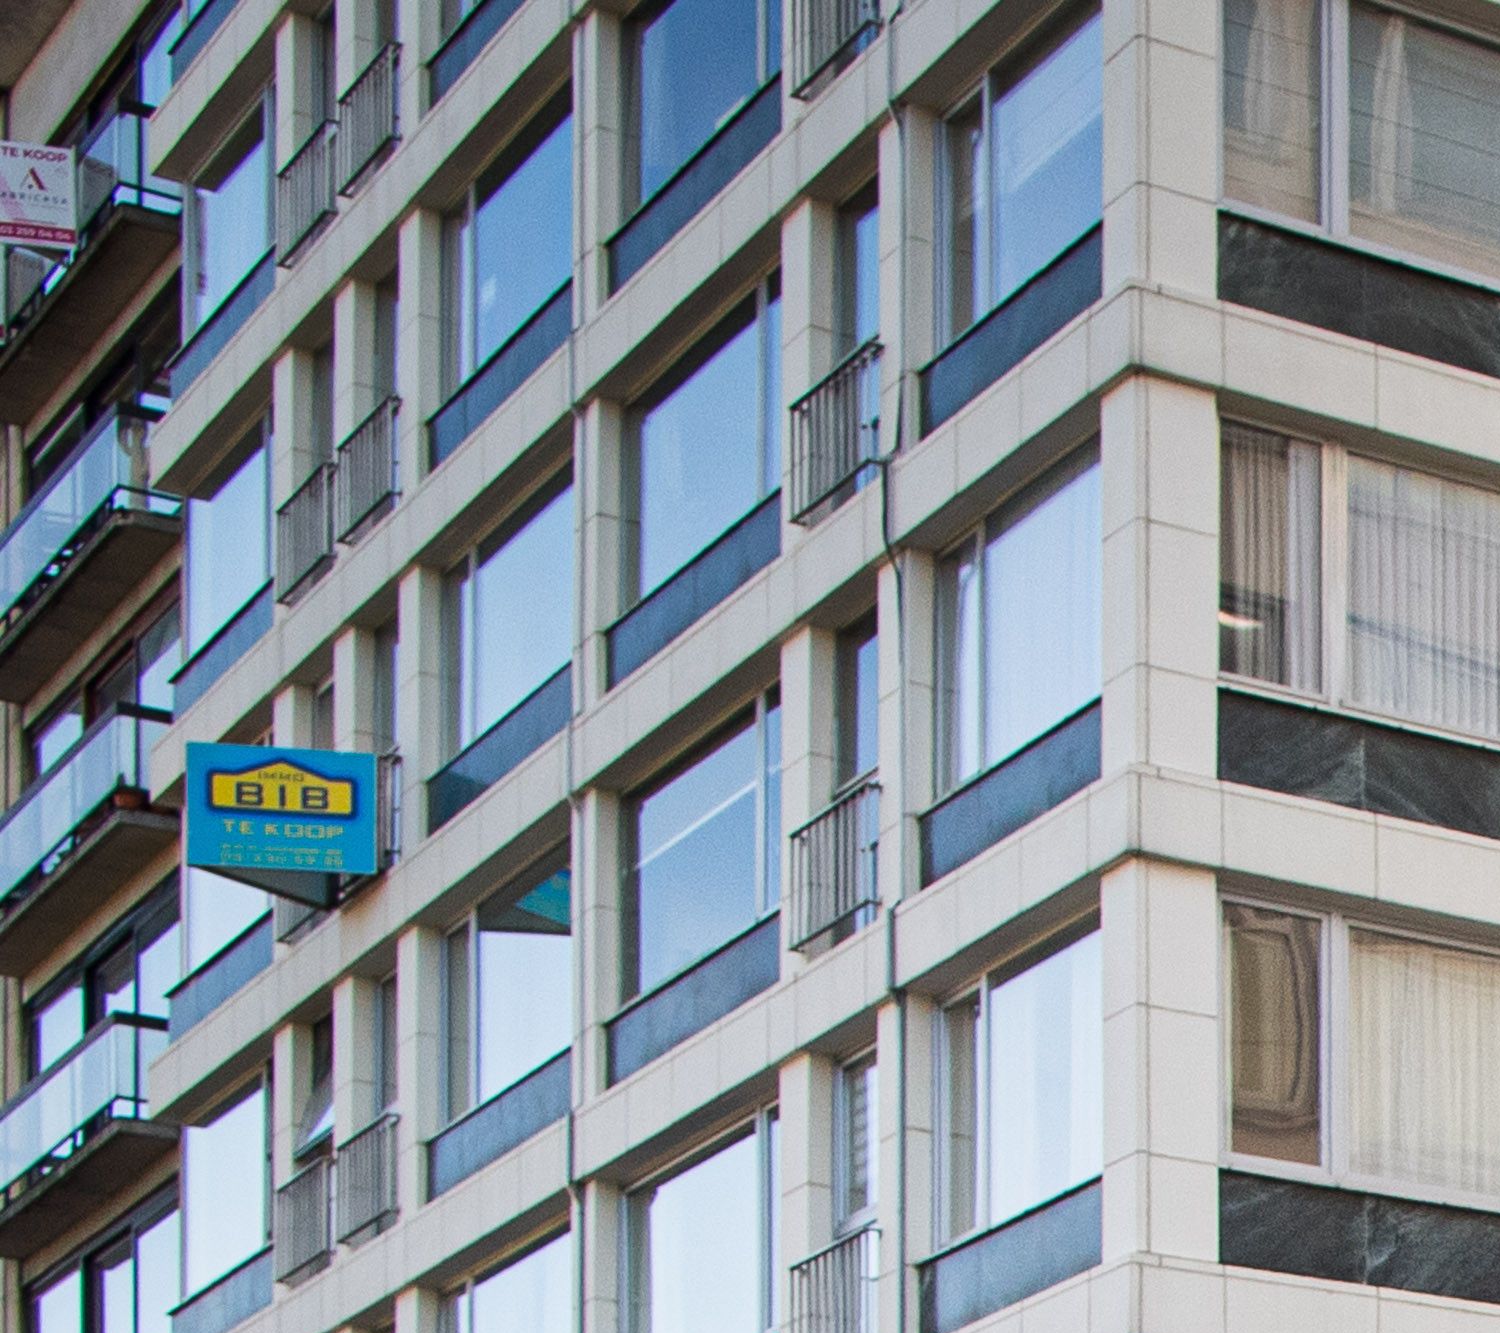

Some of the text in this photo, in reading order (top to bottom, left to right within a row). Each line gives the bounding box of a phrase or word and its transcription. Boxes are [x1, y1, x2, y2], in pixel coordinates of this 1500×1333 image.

[22, 149, 67, 162] KOOP
[235, 781, 329, 811] BIB
[223, 819, 344, 841] TE KOOP
